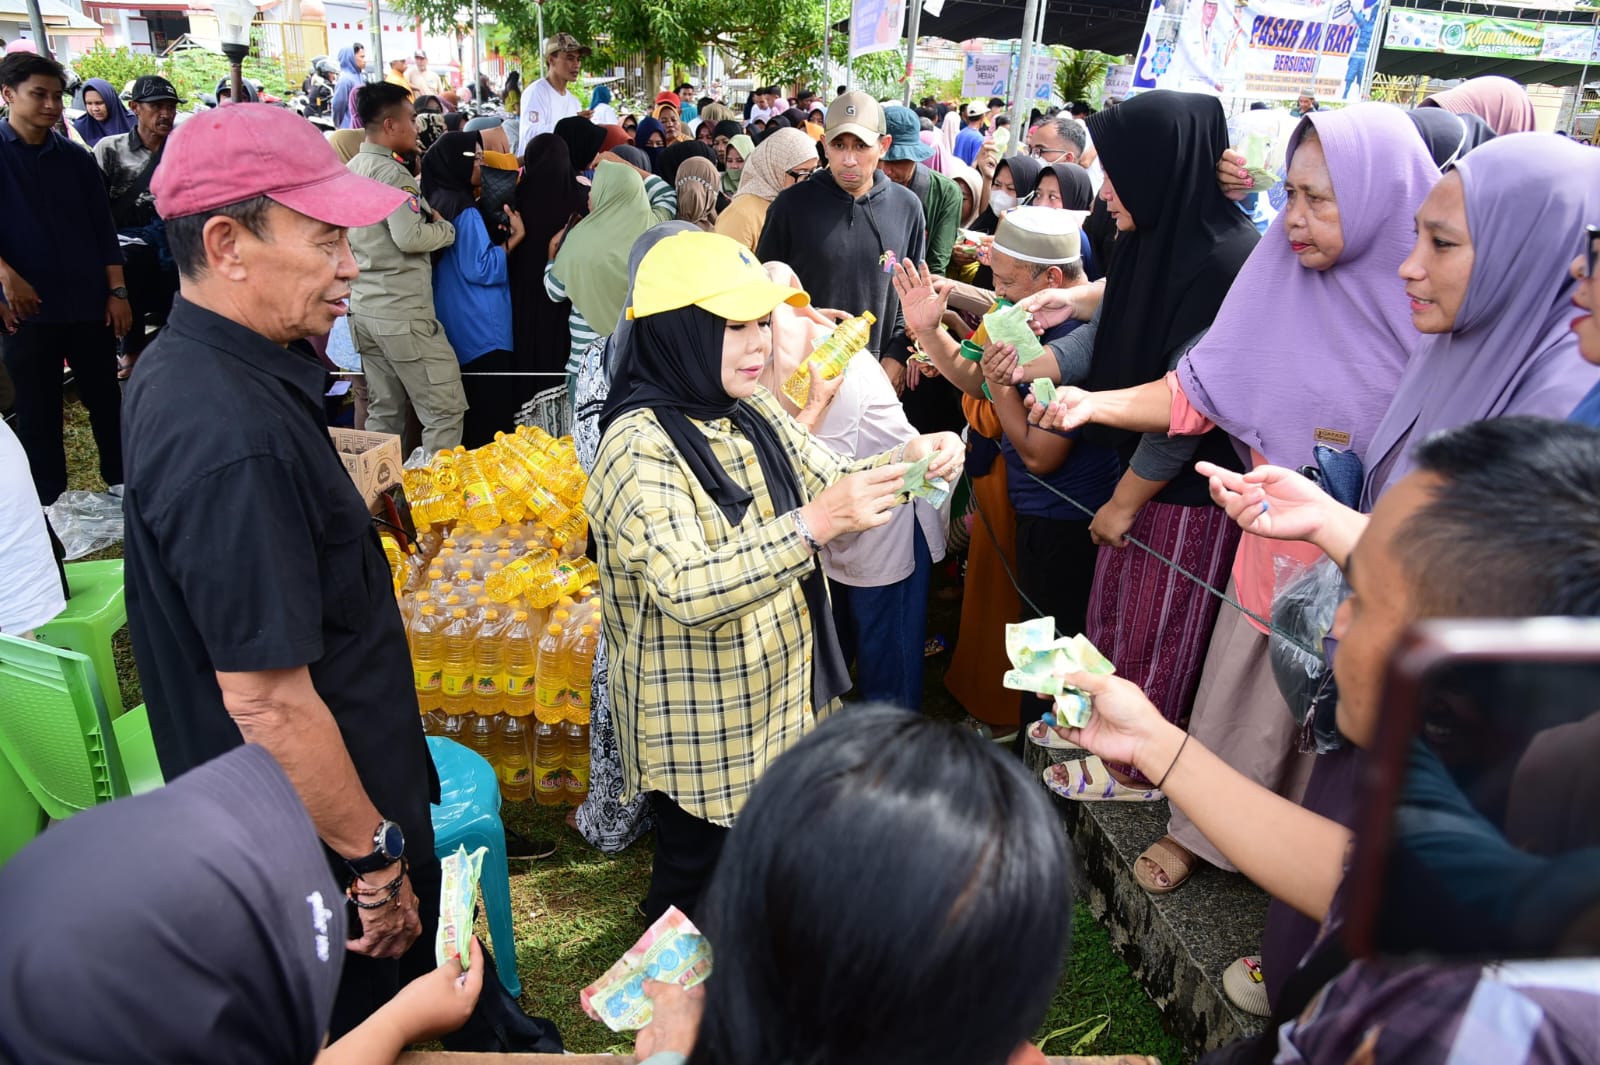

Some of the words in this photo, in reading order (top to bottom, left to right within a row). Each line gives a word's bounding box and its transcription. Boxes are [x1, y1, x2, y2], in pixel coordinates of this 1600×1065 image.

[1249, 15, 1305, 51] PASAR
[1478, 45, 1503, 54] FAIR
[845, 104, 857, 117] G
